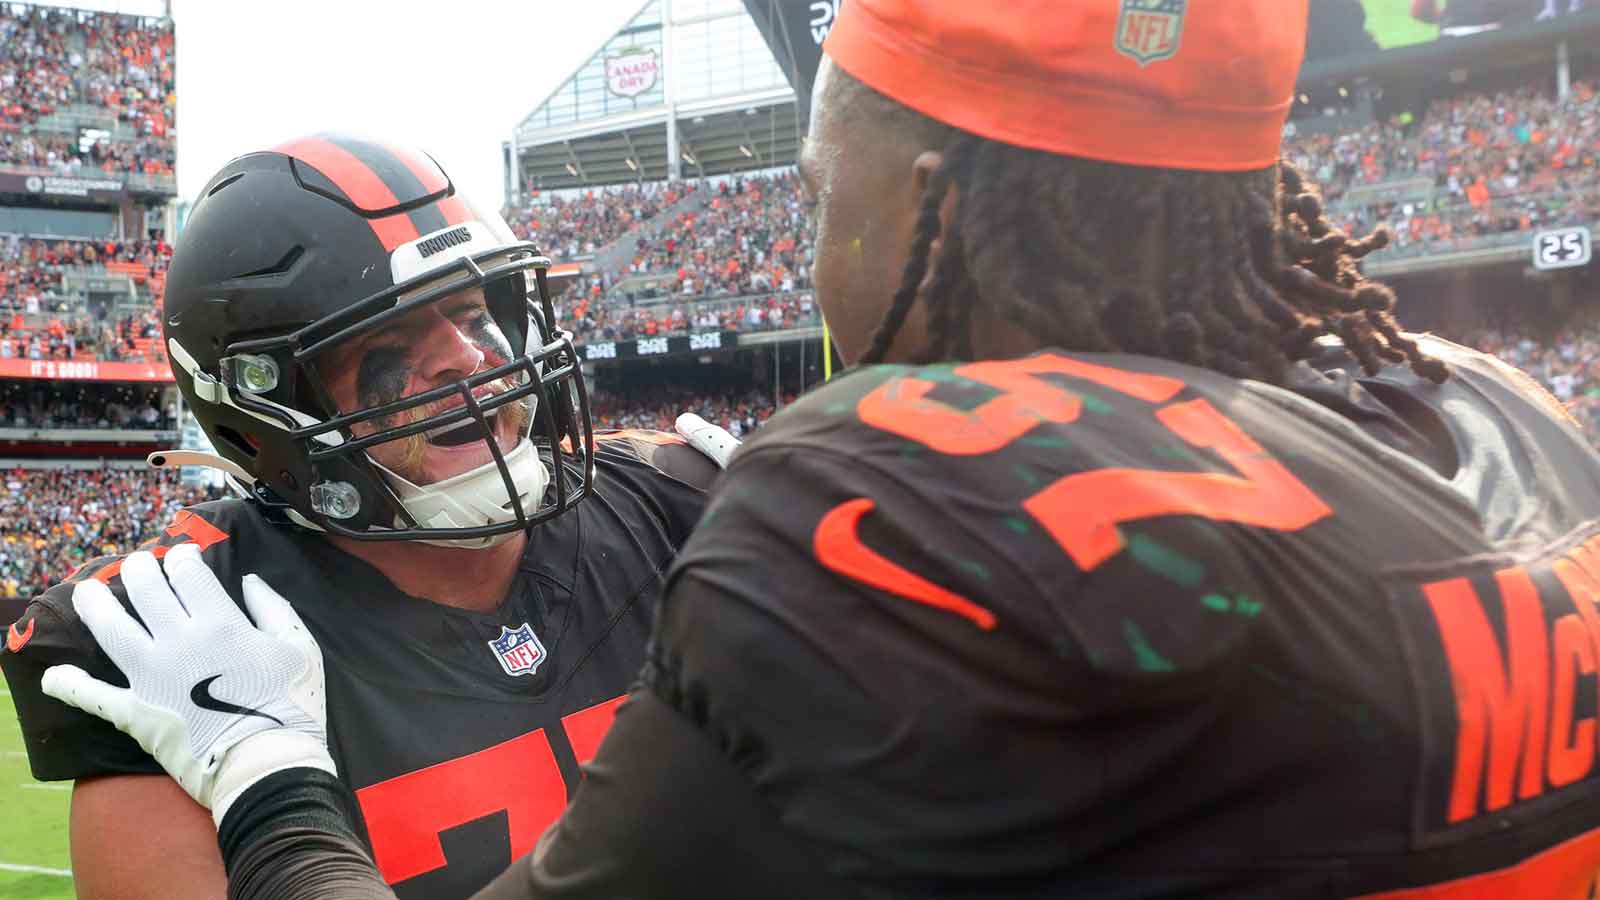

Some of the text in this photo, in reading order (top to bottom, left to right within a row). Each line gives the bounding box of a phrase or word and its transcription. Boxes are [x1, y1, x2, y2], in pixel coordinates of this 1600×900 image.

[1123, 14, 1170, 52] NFL
[607, 61, 657, 77] CANADA
[619, 76, 645, 89] DRY
[416, 226, 473, 258] BROWNS
[1541, 232, 1583, 264] 25
[503, 643, 539, 670] NFL
[355, 693, 630, 886] 7
